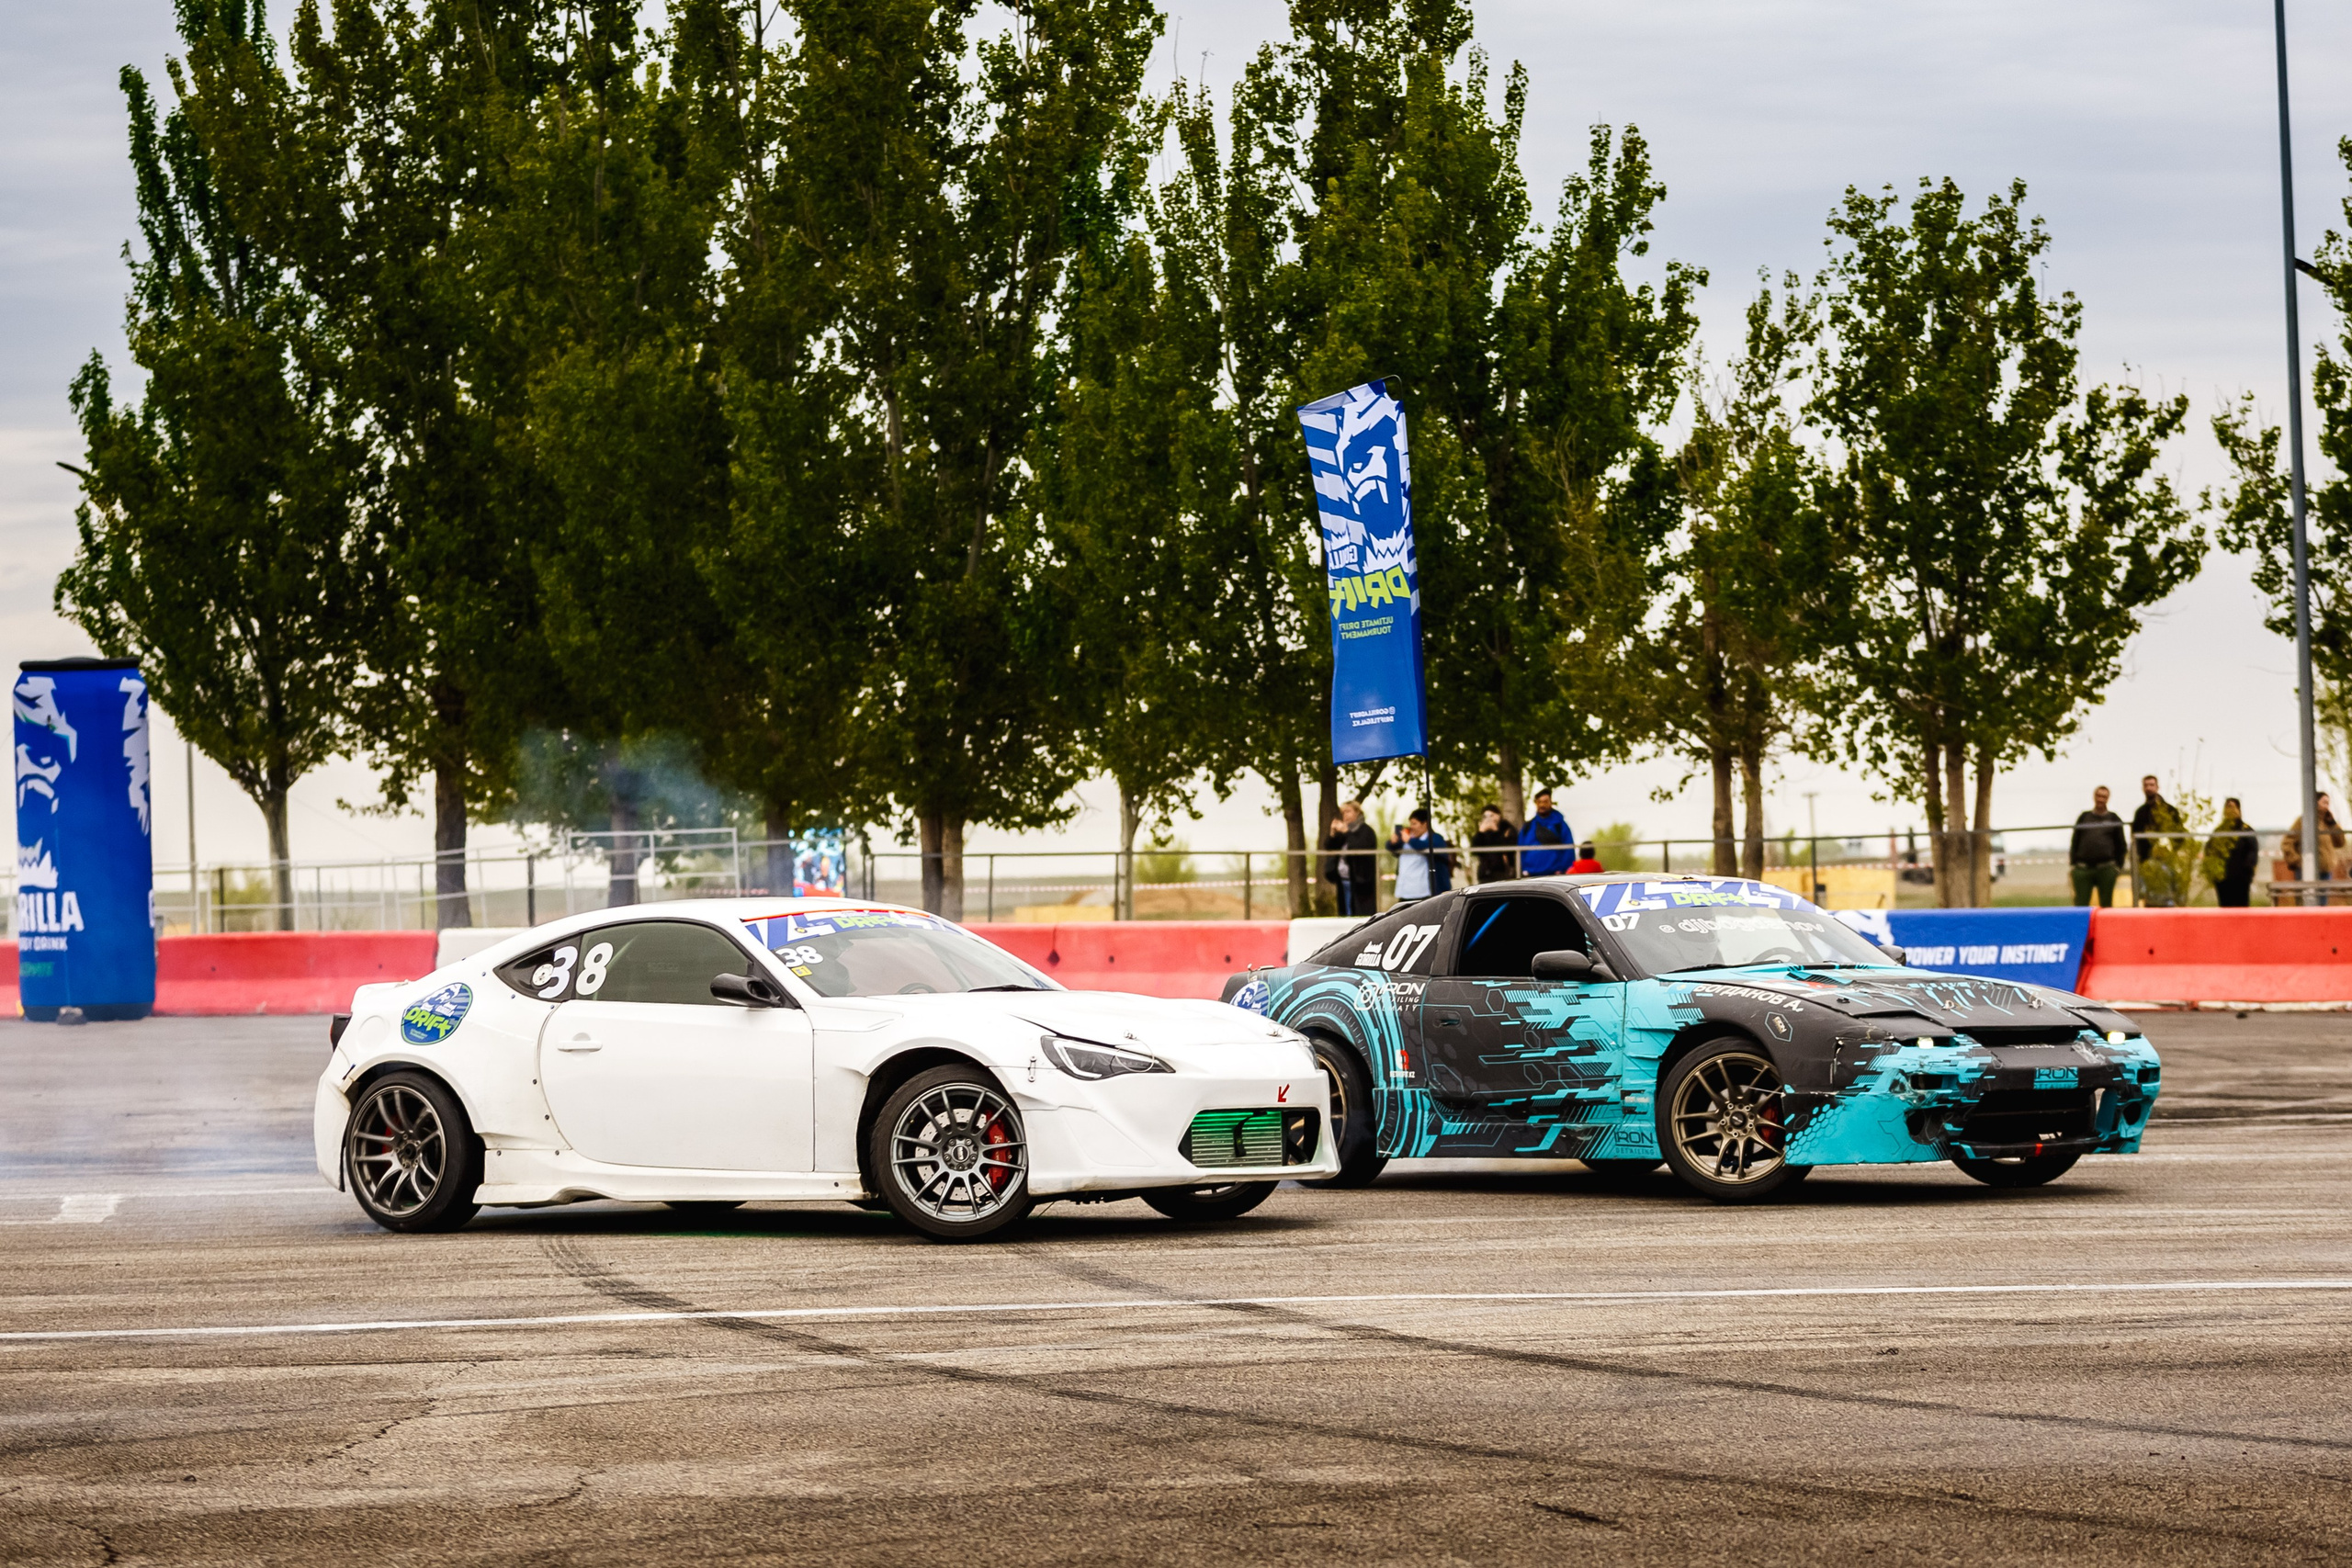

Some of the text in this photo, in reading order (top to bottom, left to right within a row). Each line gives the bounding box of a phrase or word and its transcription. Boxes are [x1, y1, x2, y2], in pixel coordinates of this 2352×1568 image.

[1671, 892, 1749, 907] DRIFT
[1601, 912, 1640, 932] 07
[33, 936, 68, 952] DRINK
[1382, 923, 1442, 972] 07
[775, 945, 824, 968] 38
[1354, 953, 1382, 966] GORILLA
[1905, 943, 2069, 965] POWER YOUR INSTINCT
[537, 942, 614, 998] 38
[1378, 982, 1426, 996] IRON
[1693, 984, 1784, 1005] БОГДАНОВ
[404, 1006, 452, 1039] DRIFT
[2034, 1066, 2078, 1079] IRON
[1614, 1131, 1654, 1145] IRON
[1615, 1146, 1655, 1156] DETAILING
